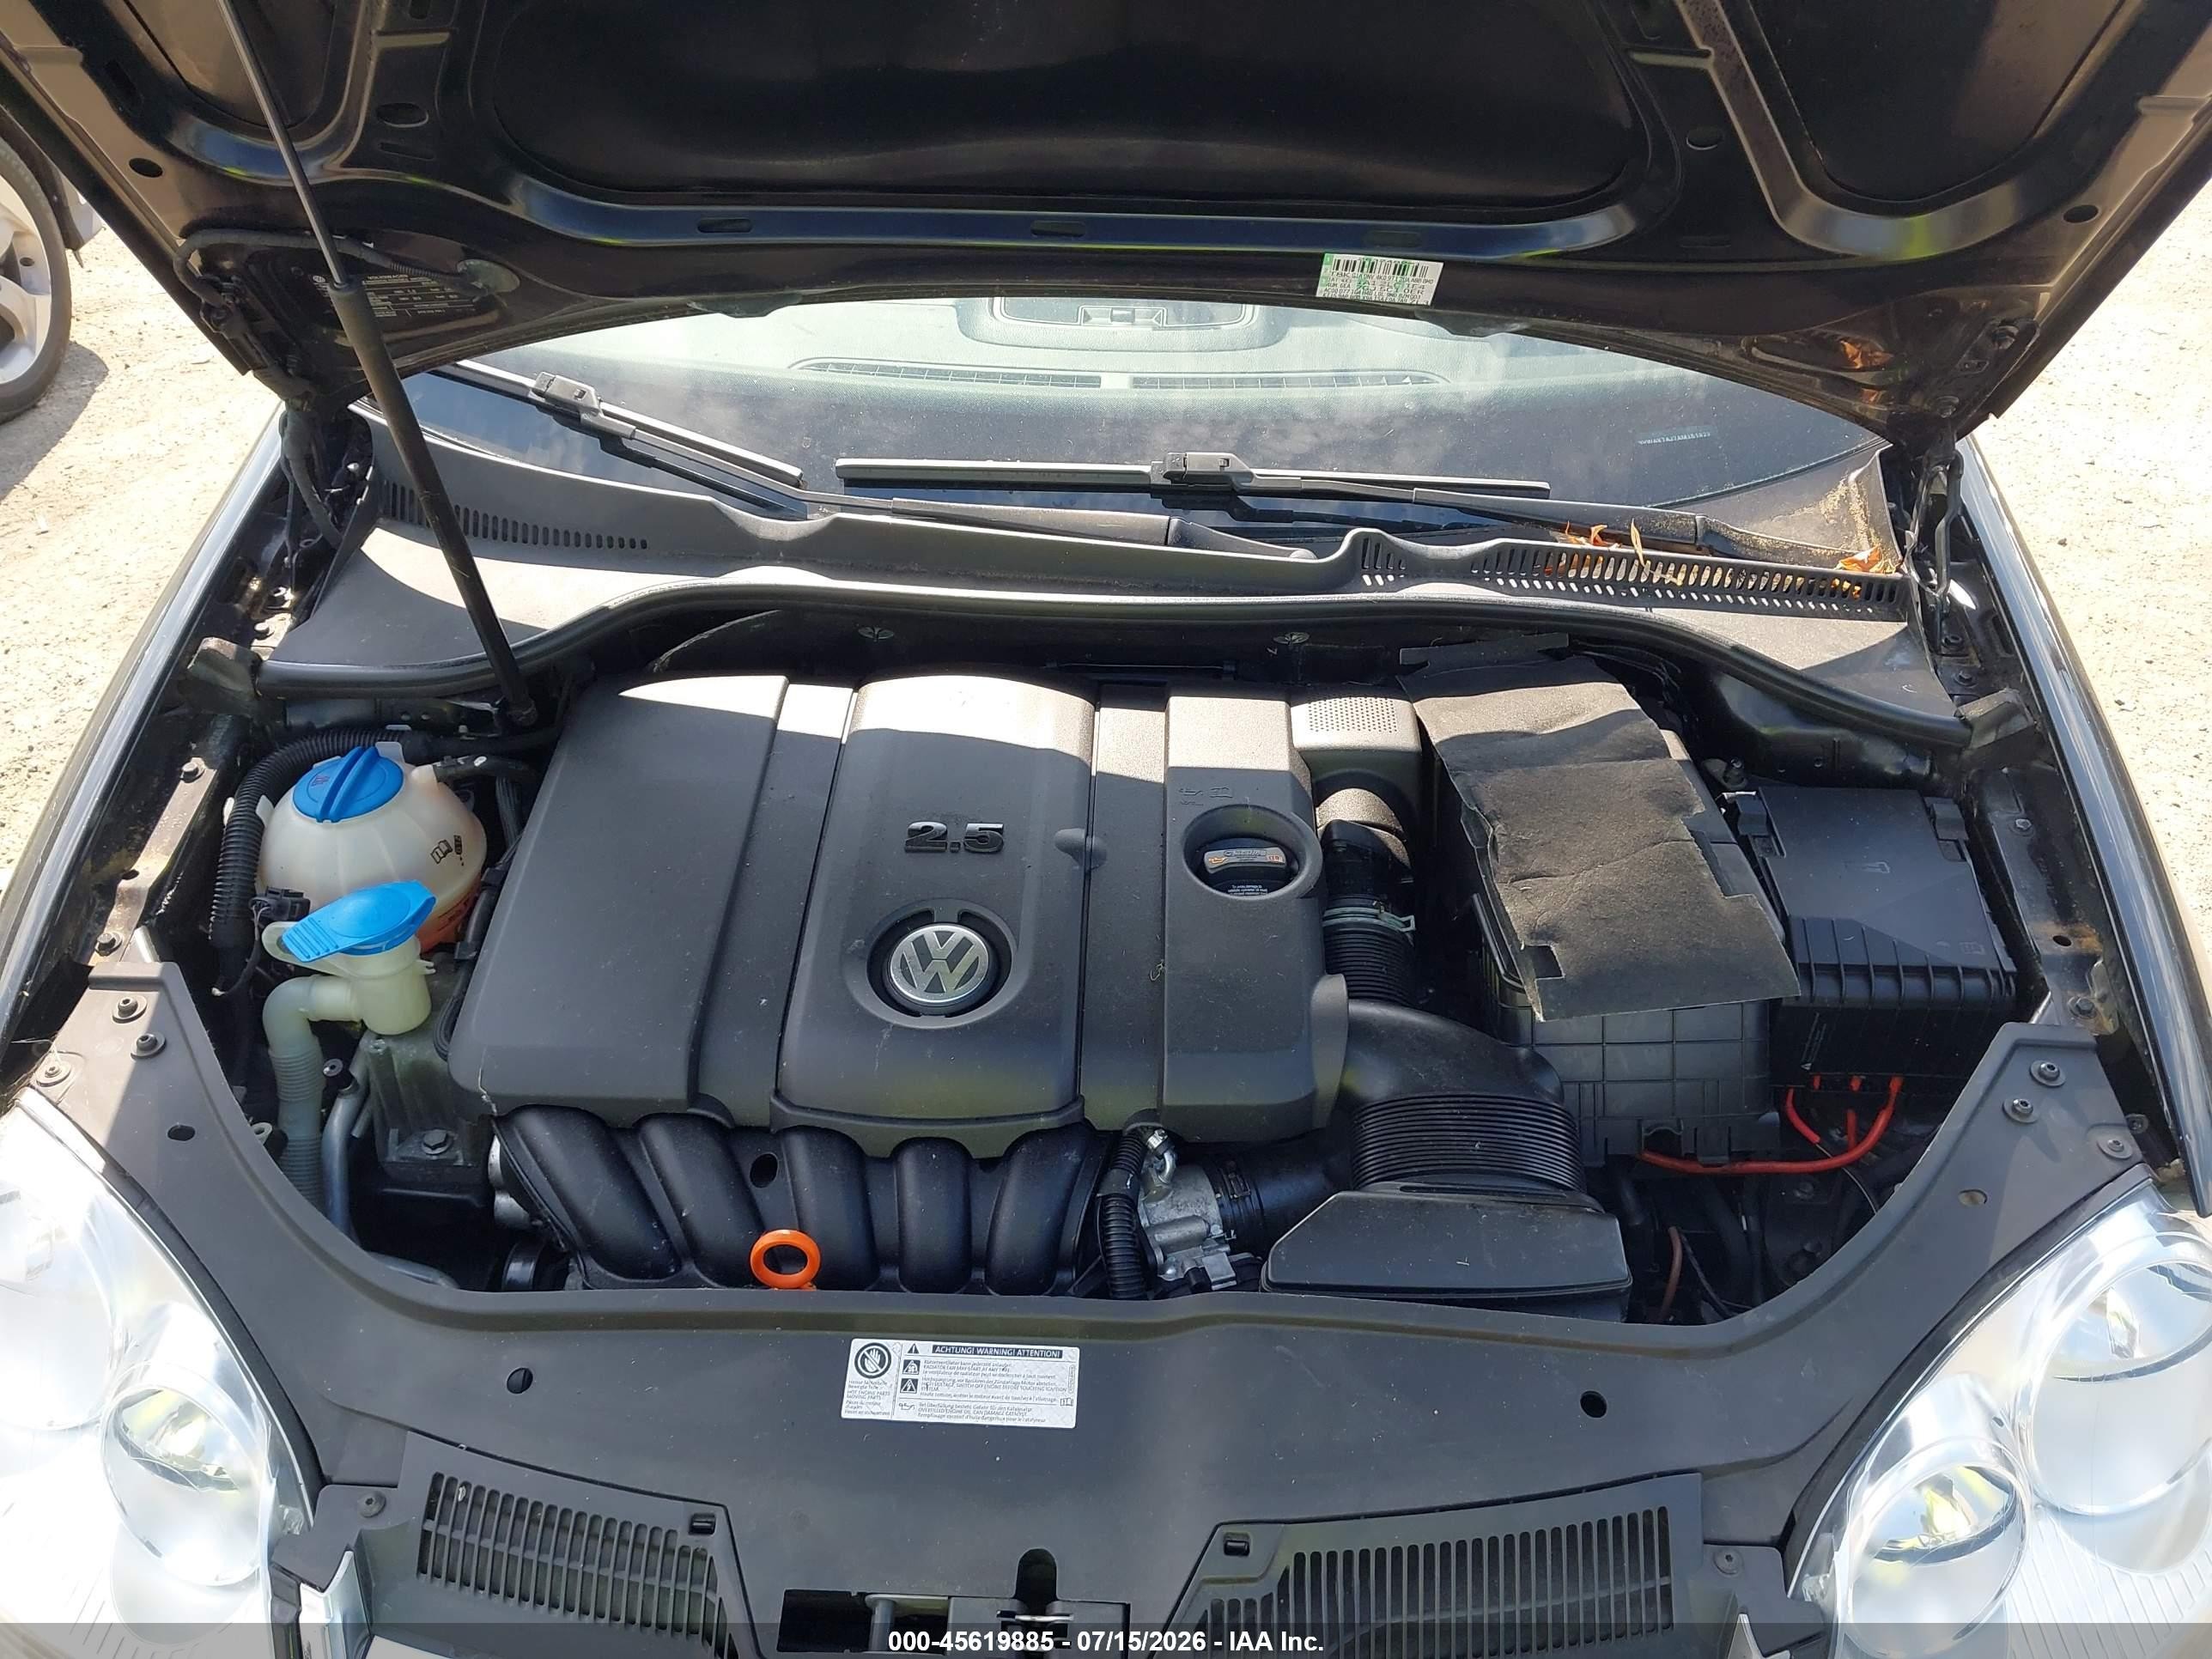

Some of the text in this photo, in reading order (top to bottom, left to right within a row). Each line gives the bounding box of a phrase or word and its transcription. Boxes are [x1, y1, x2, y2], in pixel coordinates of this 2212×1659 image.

[905, 821, 1005, 854] 2.5
[935, 1346, 1060, 1358] ACHTUNG! WARNING! ATTENTION!
